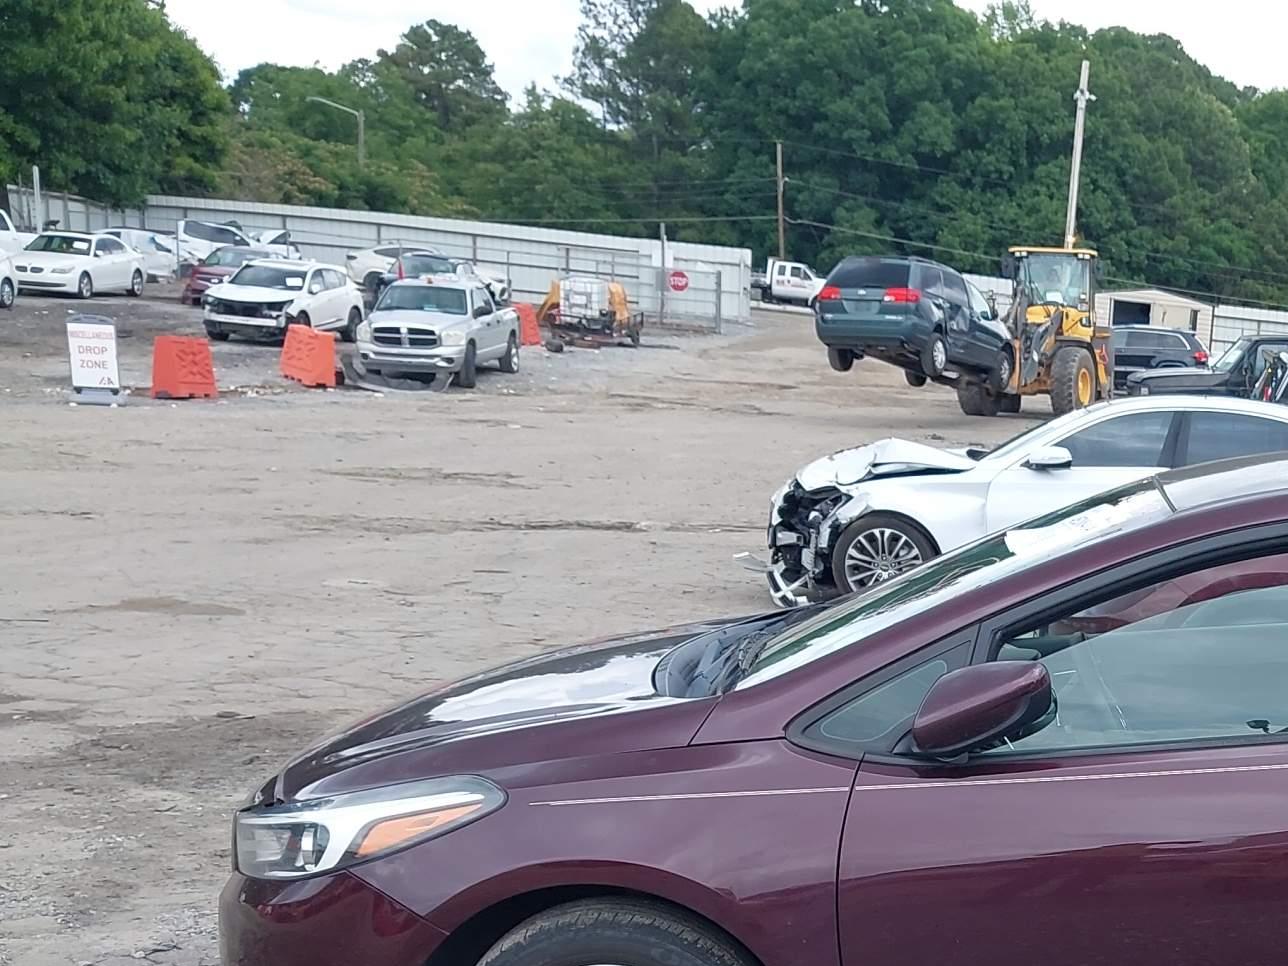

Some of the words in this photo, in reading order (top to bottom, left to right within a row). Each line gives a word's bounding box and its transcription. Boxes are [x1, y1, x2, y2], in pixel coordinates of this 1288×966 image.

[670, 276, 688, 286] STOP
[77, 345, 108, 355] DROP
[79, 359, 109, 369] ZONE
